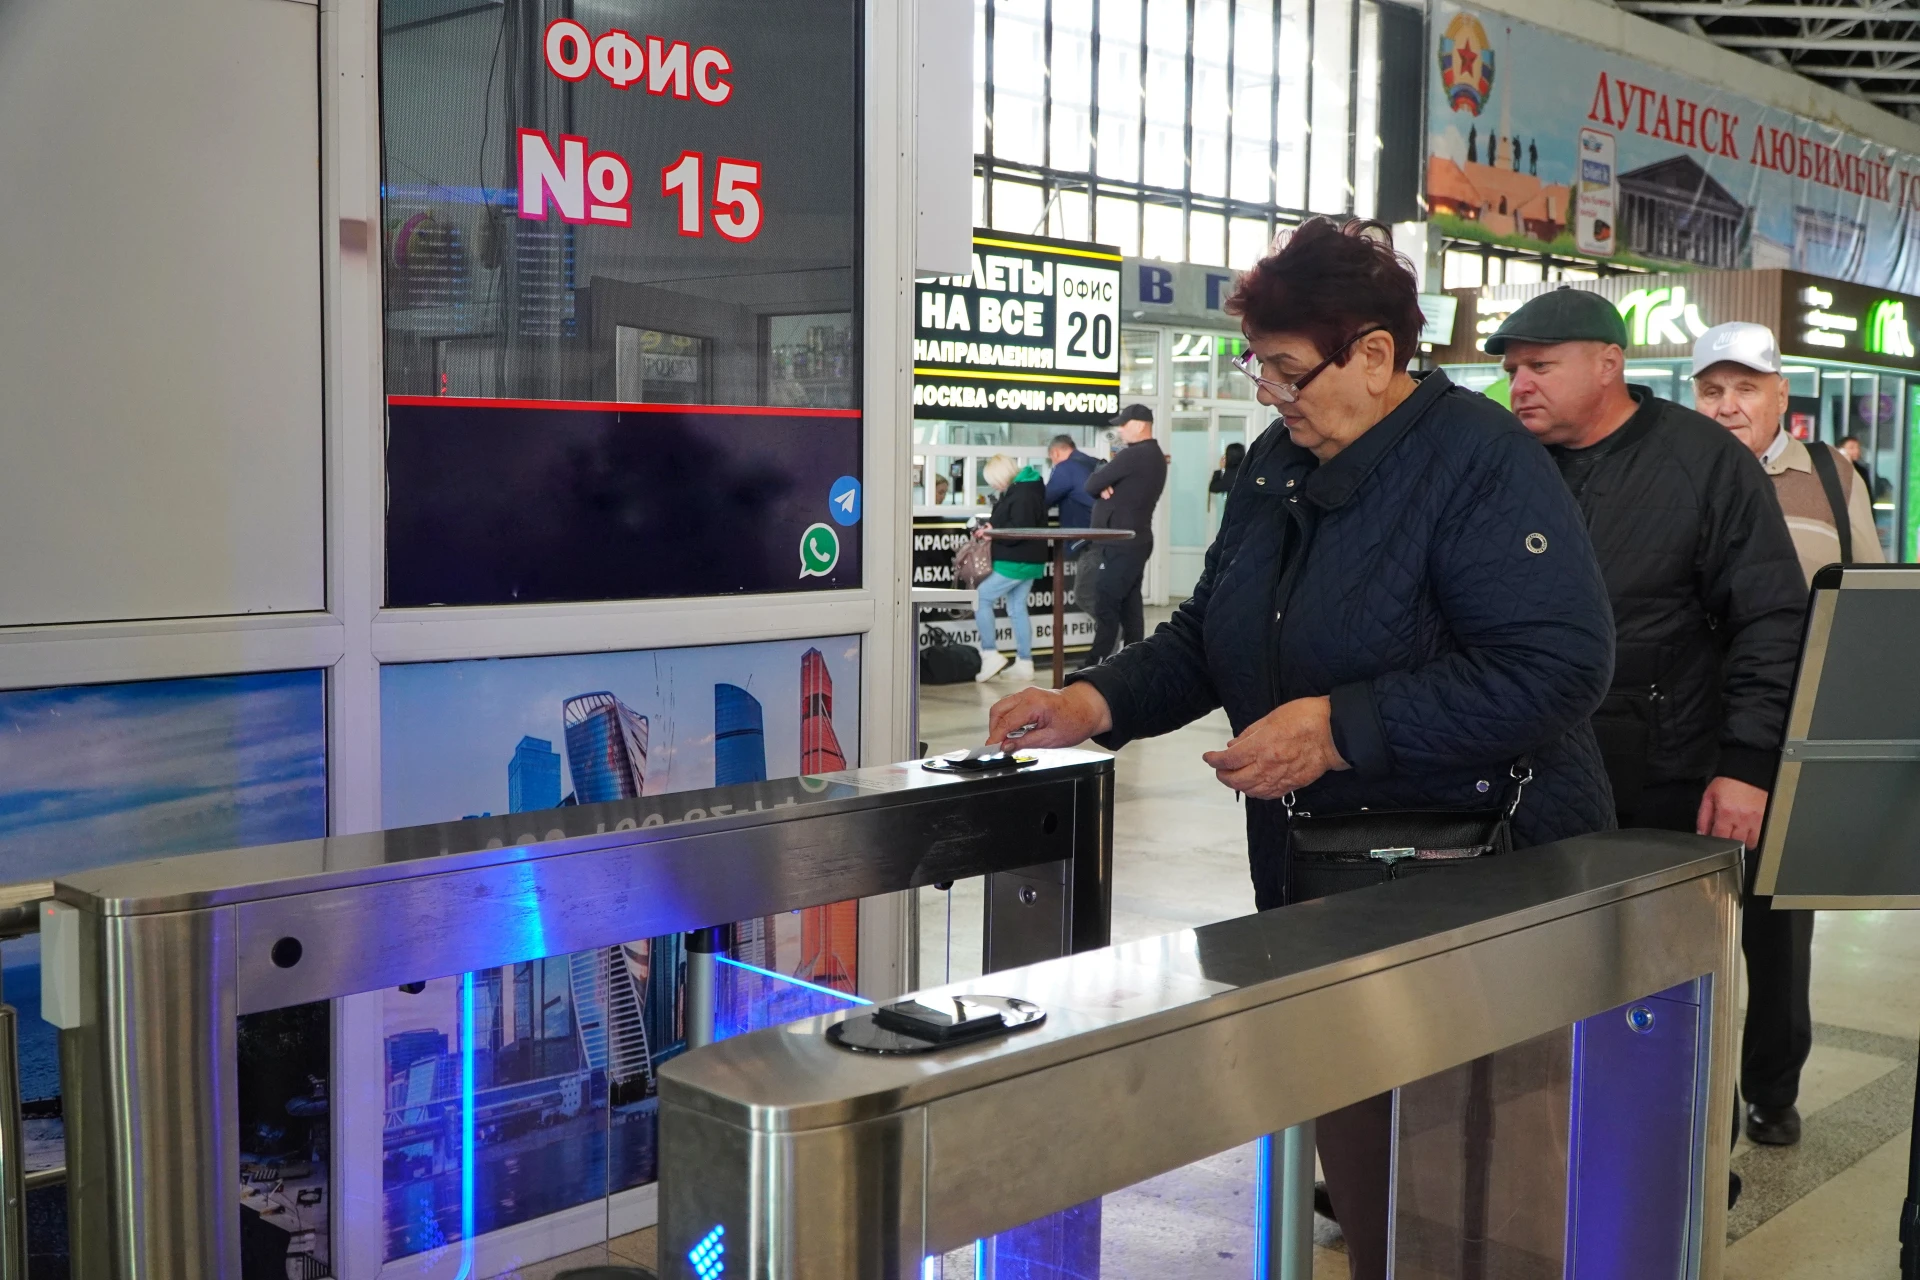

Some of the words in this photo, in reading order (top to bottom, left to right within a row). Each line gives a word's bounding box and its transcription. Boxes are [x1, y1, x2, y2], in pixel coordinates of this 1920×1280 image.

[543, 18, 734, 106] ОФИС
[1588, 71, 1740, 161] ЛУГАНСК
[1750, 124, 1891, 203] ЛЮБИМЫЙ
[517, 127, 632, 228] №
[662, 150, 764, 243] 15
[915, 253, 1053, 296] ЛЕТЫ
[1063, 277, 1113, 302] ОФИС
[1139, 265, 1174, 305] В
[921, 292, 971, 331] НА
[979, 297, 1044, 337] ВСЕ
[1066, 311, 1112, 360] 20
[914, 339, 1054, 369] НАПРАВЛЕНИЯ
